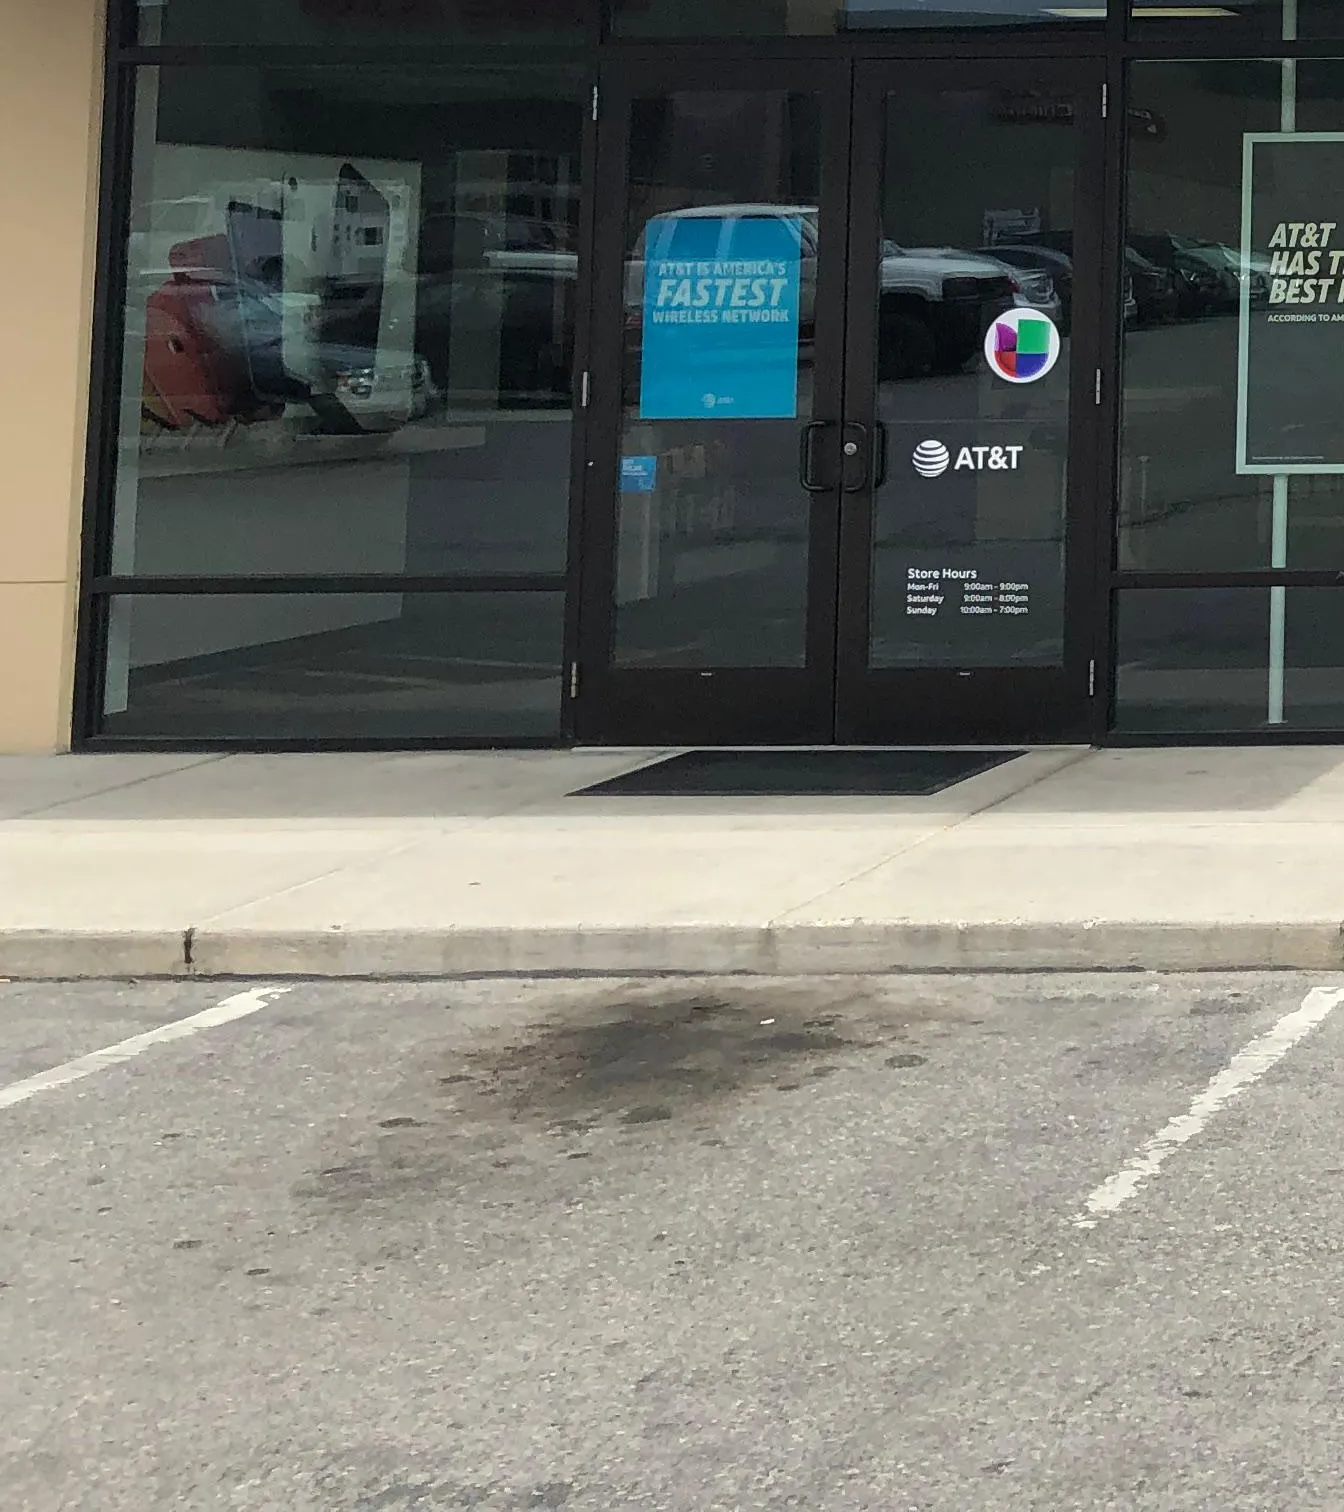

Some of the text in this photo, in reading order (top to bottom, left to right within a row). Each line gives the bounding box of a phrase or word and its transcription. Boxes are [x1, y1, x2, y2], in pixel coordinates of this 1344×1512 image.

[1268, 223, 1336, 248] AT&T
[713, 260, 786, 276] AMERICA'S
[1270, 251, 1322, 275] HAS
[656, 278, 788, 307] FASTEST
[1268, 278, 1335, 304] BEST
[653, 308, 789, 323] WIRELESS NETWORK
[1267, 314, 1316, 322] ACCORDING
[1318, 314, 1330, 322] TO
[955, 446, 1023, 470] AT&T
[908, 568, 977, 579] Store Hours
[907, 583, 939, 591] Mon-Fri
[907, 594, 944, 604] Saturday
[907, 606, 938, 616] Sunday
